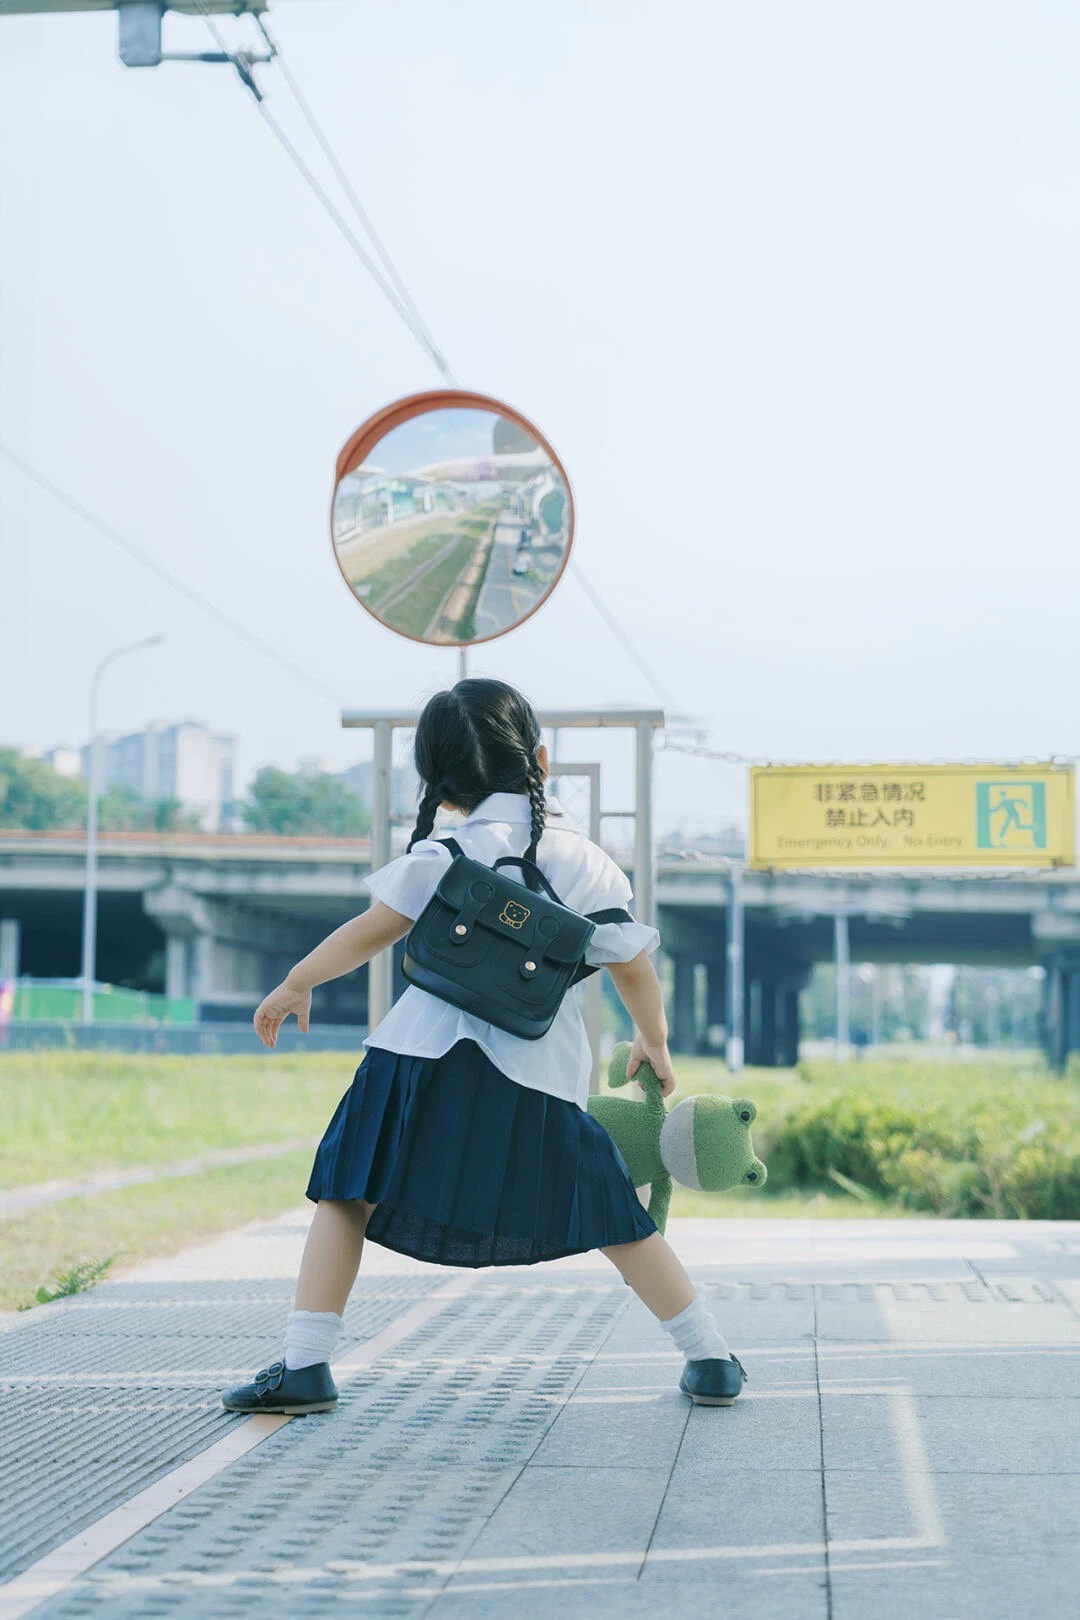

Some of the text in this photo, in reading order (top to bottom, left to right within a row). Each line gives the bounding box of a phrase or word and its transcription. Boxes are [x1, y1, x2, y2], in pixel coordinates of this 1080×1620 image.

[814, 782, 925, 802] 非紧急情况
[826, 808, 914, 828] 禁止入内
[777, 836, 851, 850] Emergency
[903, 836, 923, 847] No
[926, 836, 962, 850] Entry
